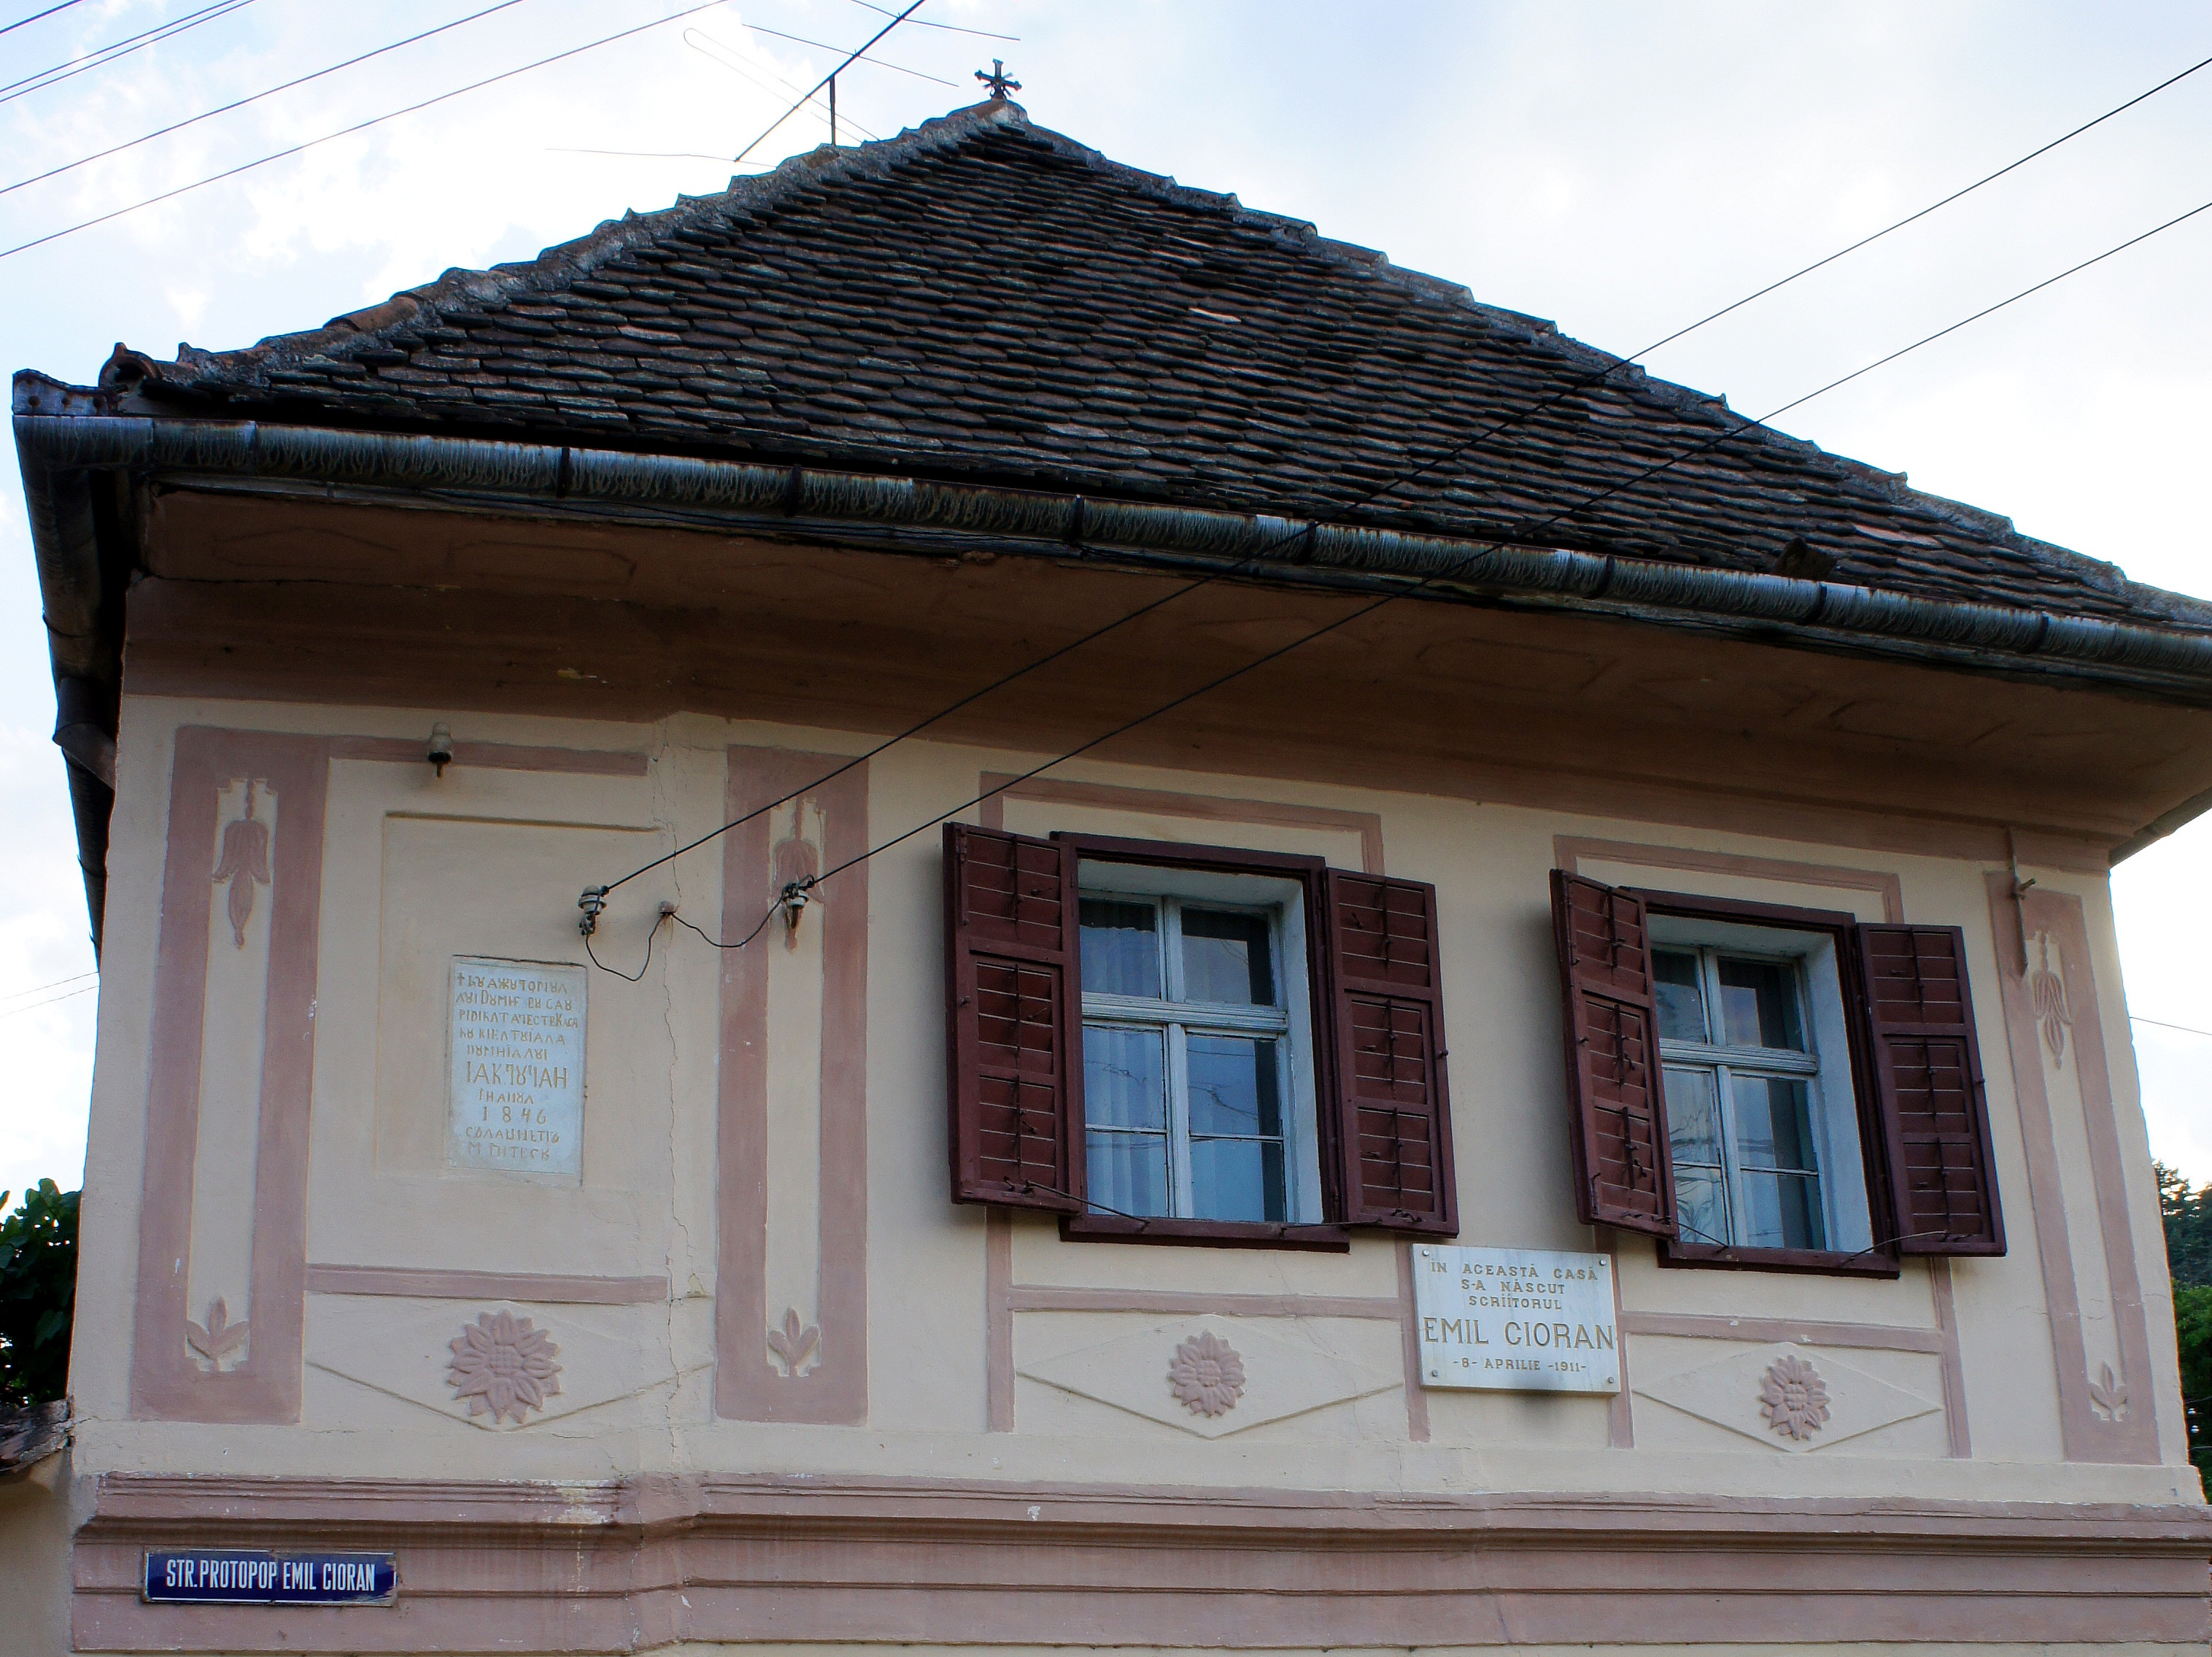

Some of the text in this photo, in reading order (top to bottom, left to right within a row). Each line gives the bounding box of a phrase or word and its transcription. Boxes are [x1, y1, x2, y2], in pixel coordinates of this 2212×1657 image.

[1461, 1279, 1486, 1291] S-A
[1423, 1316, 1614, 1350] EMIL CIORAN
[1484, 1358, 1541, 1371] APRILIE
[283, 1561, 317, 1590] EMIL
[322, 1563, 375, 1591] CIORAN
